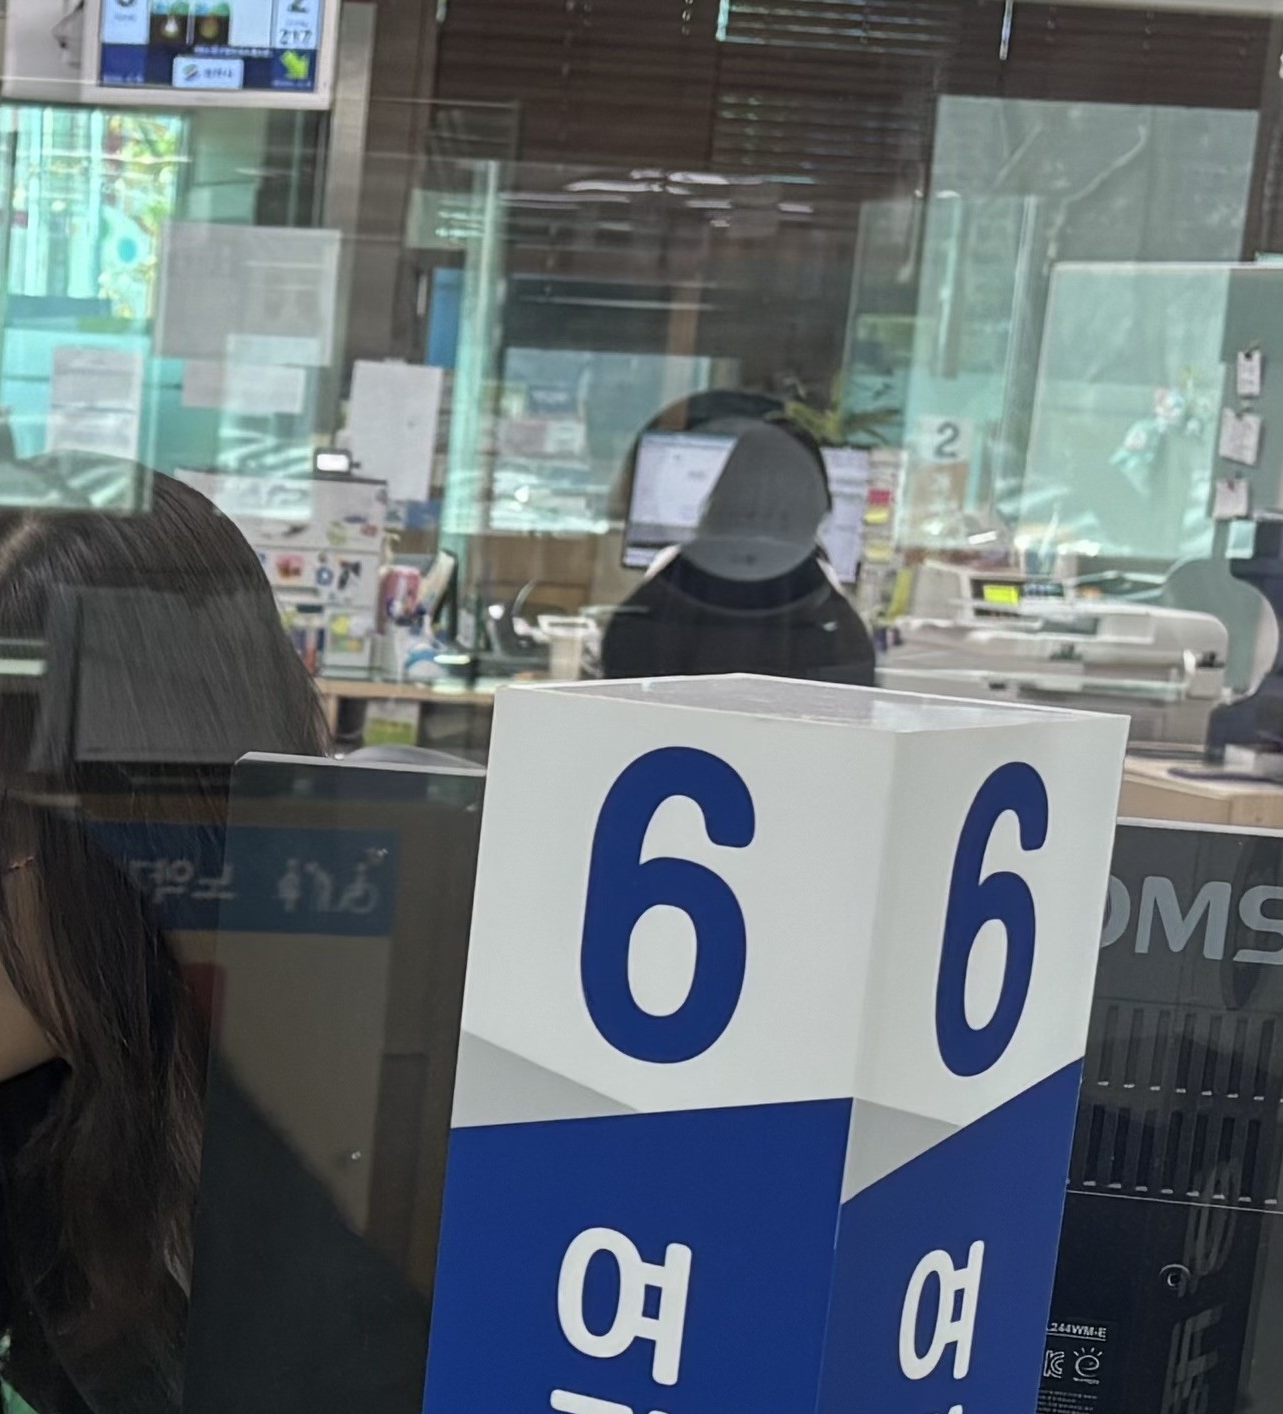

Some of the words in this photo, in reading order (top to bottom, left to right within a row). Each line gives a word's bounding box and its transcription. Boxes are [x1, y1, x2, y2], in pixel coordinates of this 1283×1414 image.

[933, 421, 960, 459] 2
[580, 746, 756, 1064] 6
[936, 761, 1049, 1077] 6
